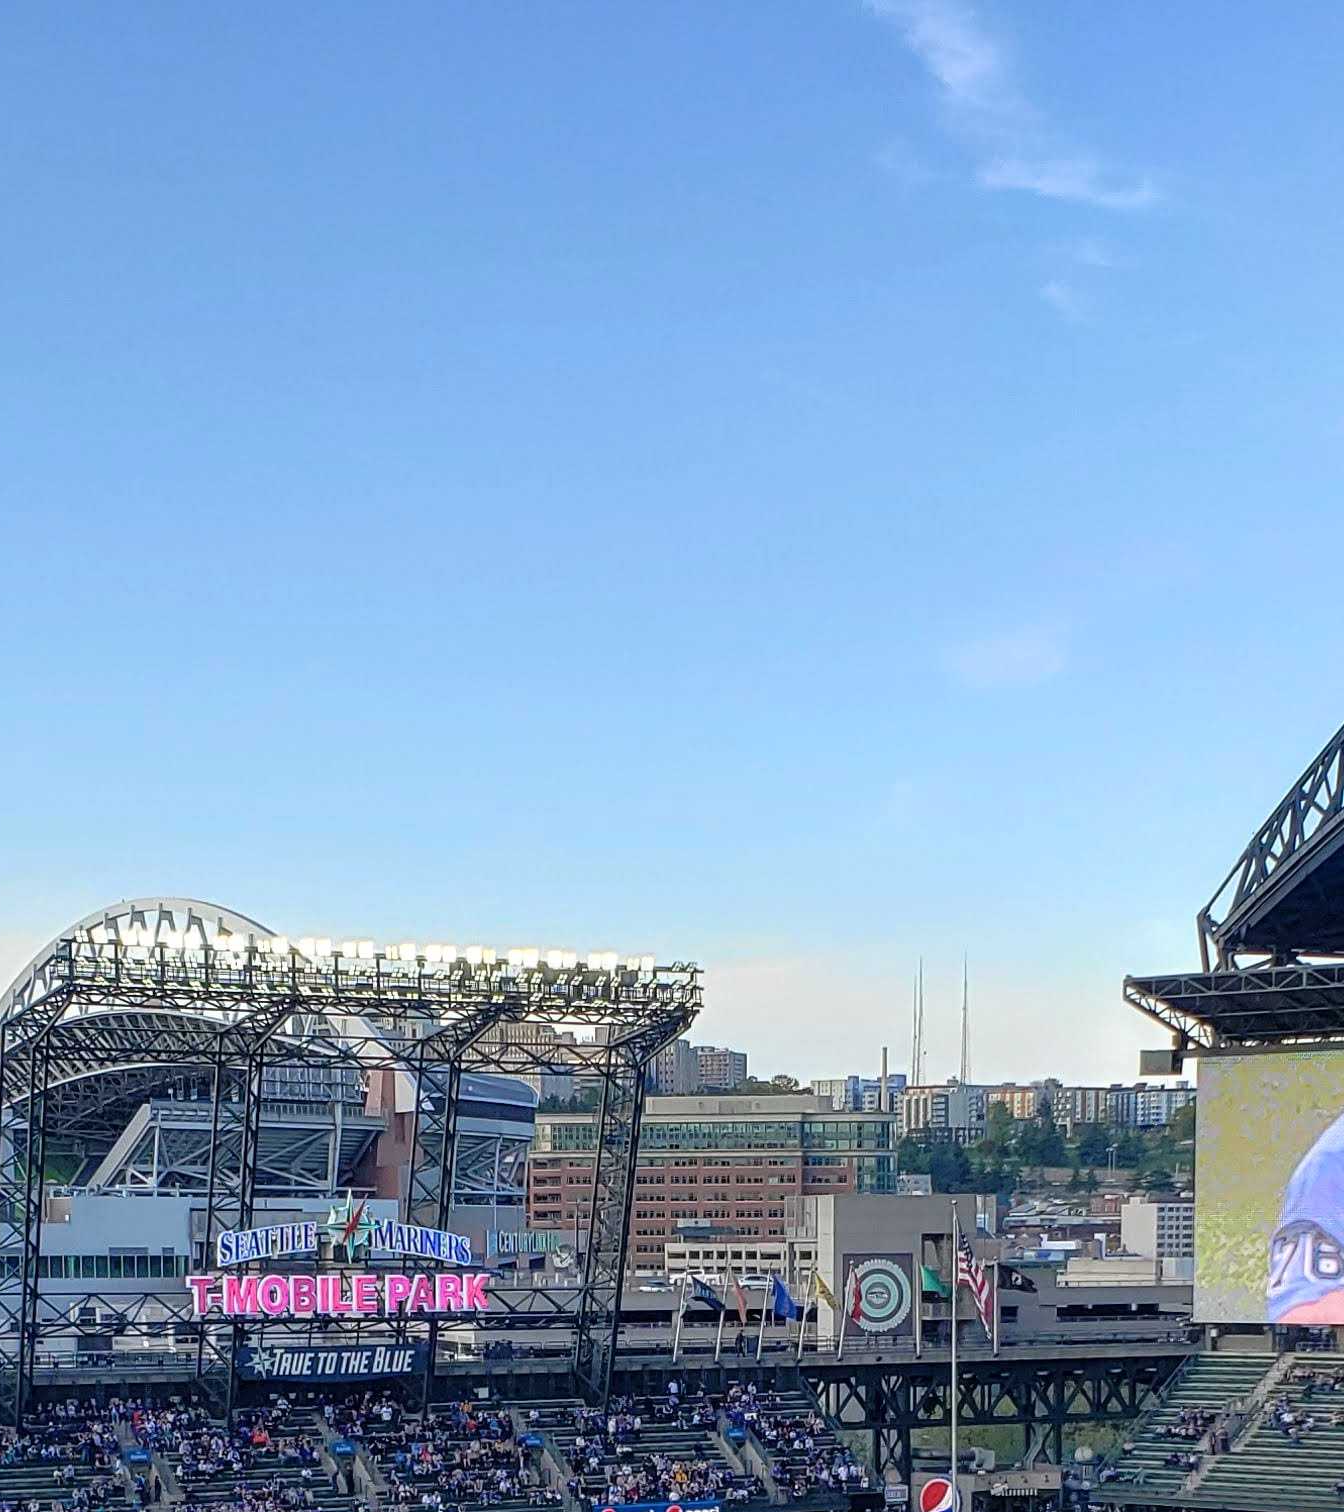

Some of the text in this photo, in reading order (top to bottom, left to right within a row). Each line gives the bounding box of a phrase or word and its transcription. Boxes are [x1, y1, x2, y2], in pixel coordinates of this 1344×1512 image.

[218, 1218, 471, 1267] SEATTLE MARINERS
[186, 1273, 492, 1316] T-MOBILE PARK
[272, 1346, 414, 1376] TRUE TO THE BLUE
